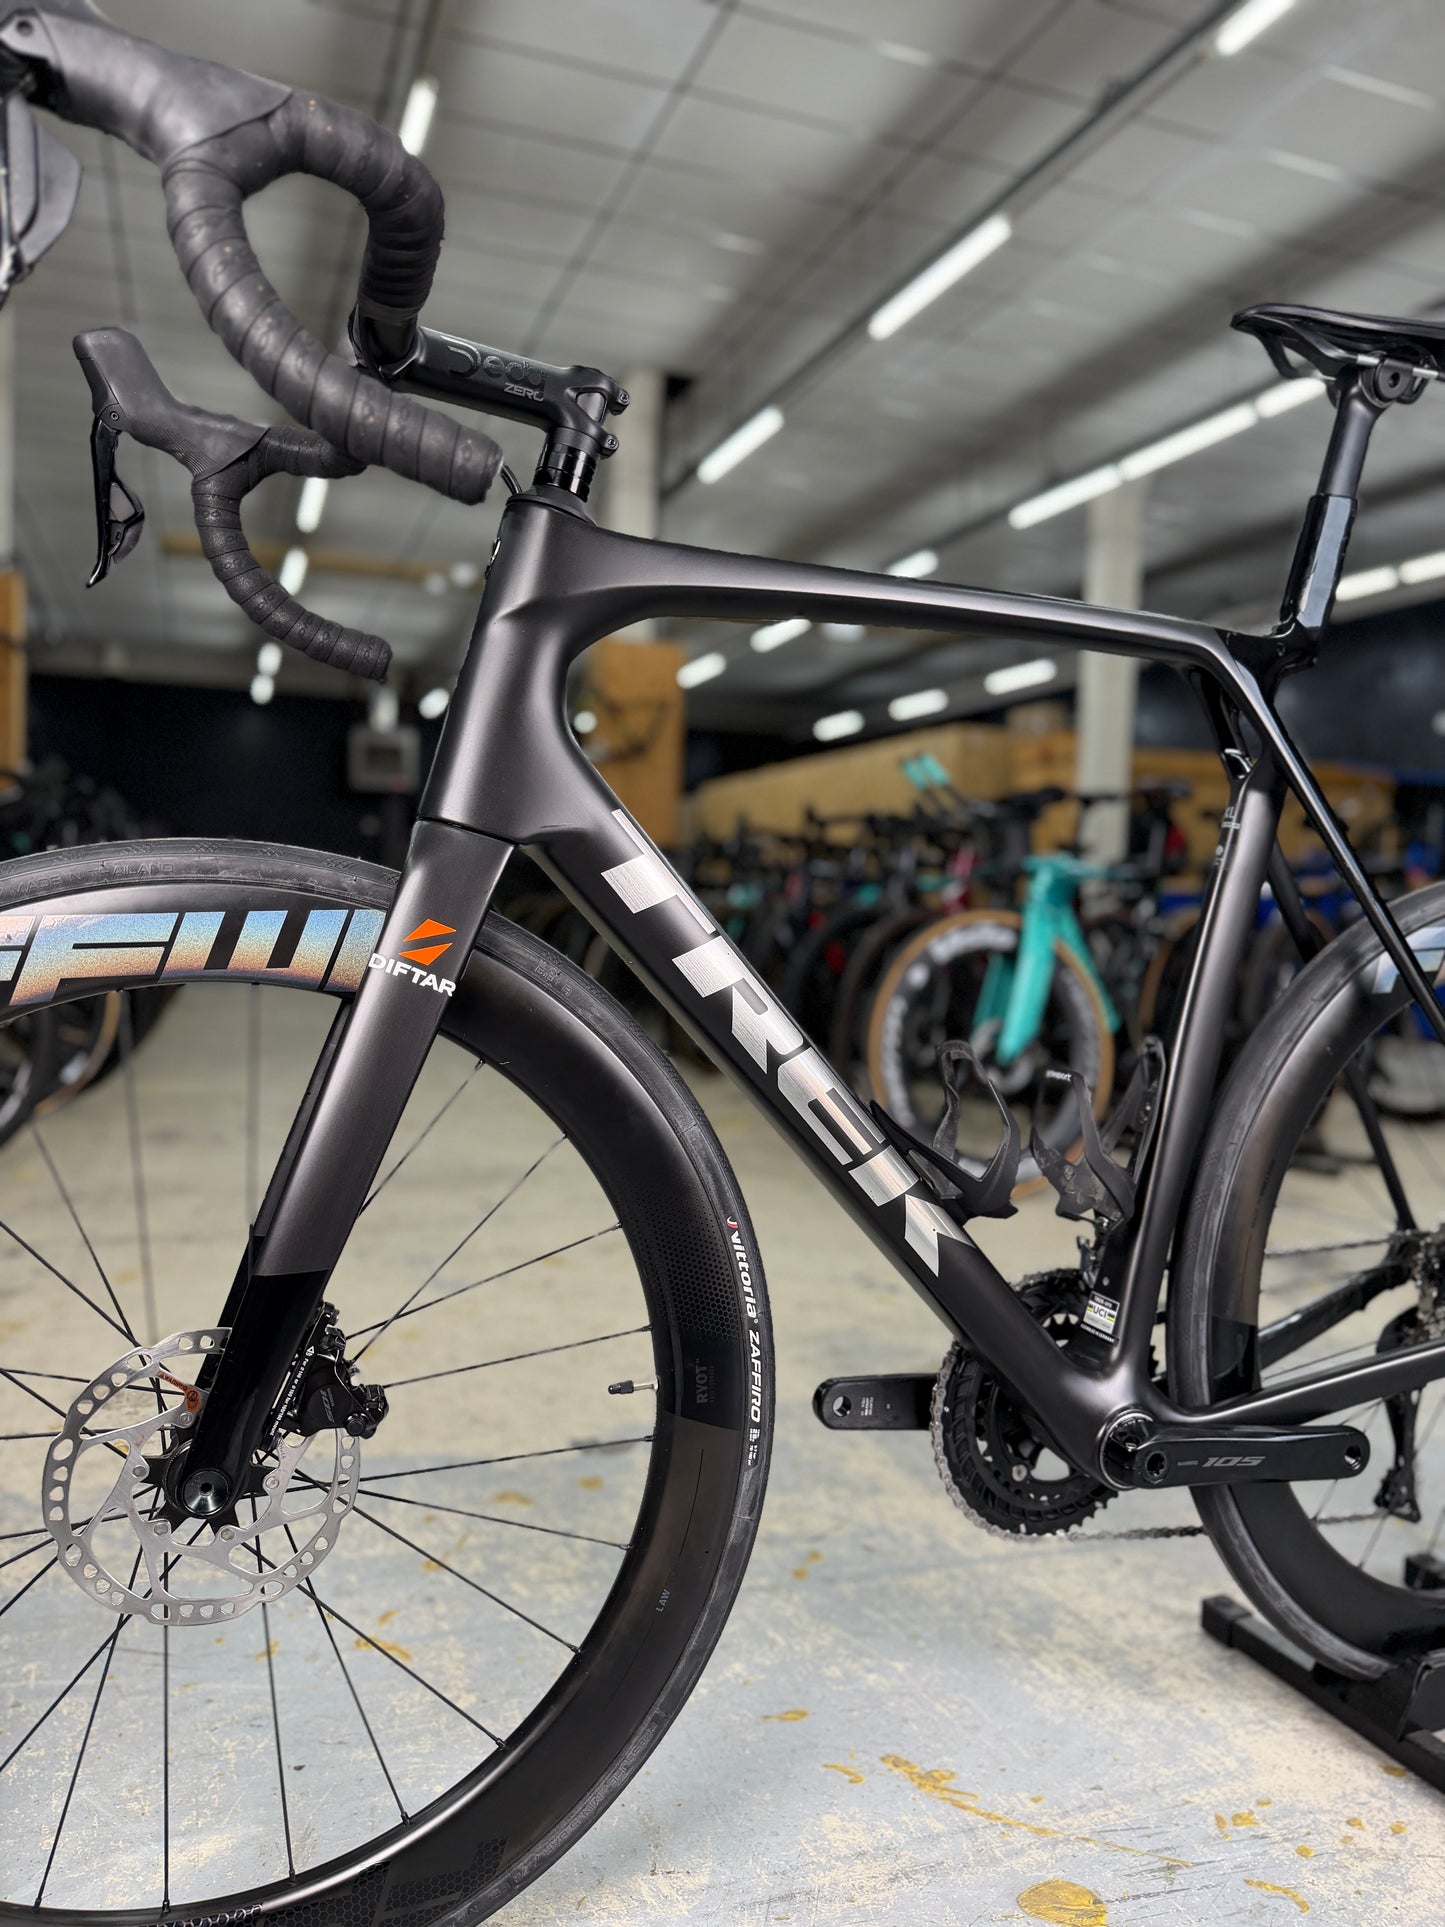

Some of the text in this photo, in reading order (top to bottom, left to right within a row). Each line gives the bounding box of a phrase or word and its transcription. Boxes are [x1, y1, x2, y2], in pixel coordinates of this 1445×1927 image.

[368, 952, 457, 997] DIFTAR
[600, 808, 975, 1278] TREK
[1092, 1304, 1108, 1318] UCI
[695, 1364, 709, 1403] RYOT
[748, 1329, 762, 1423] ZAFFIRO
[1201, 1456, 1266, 1468] 105
